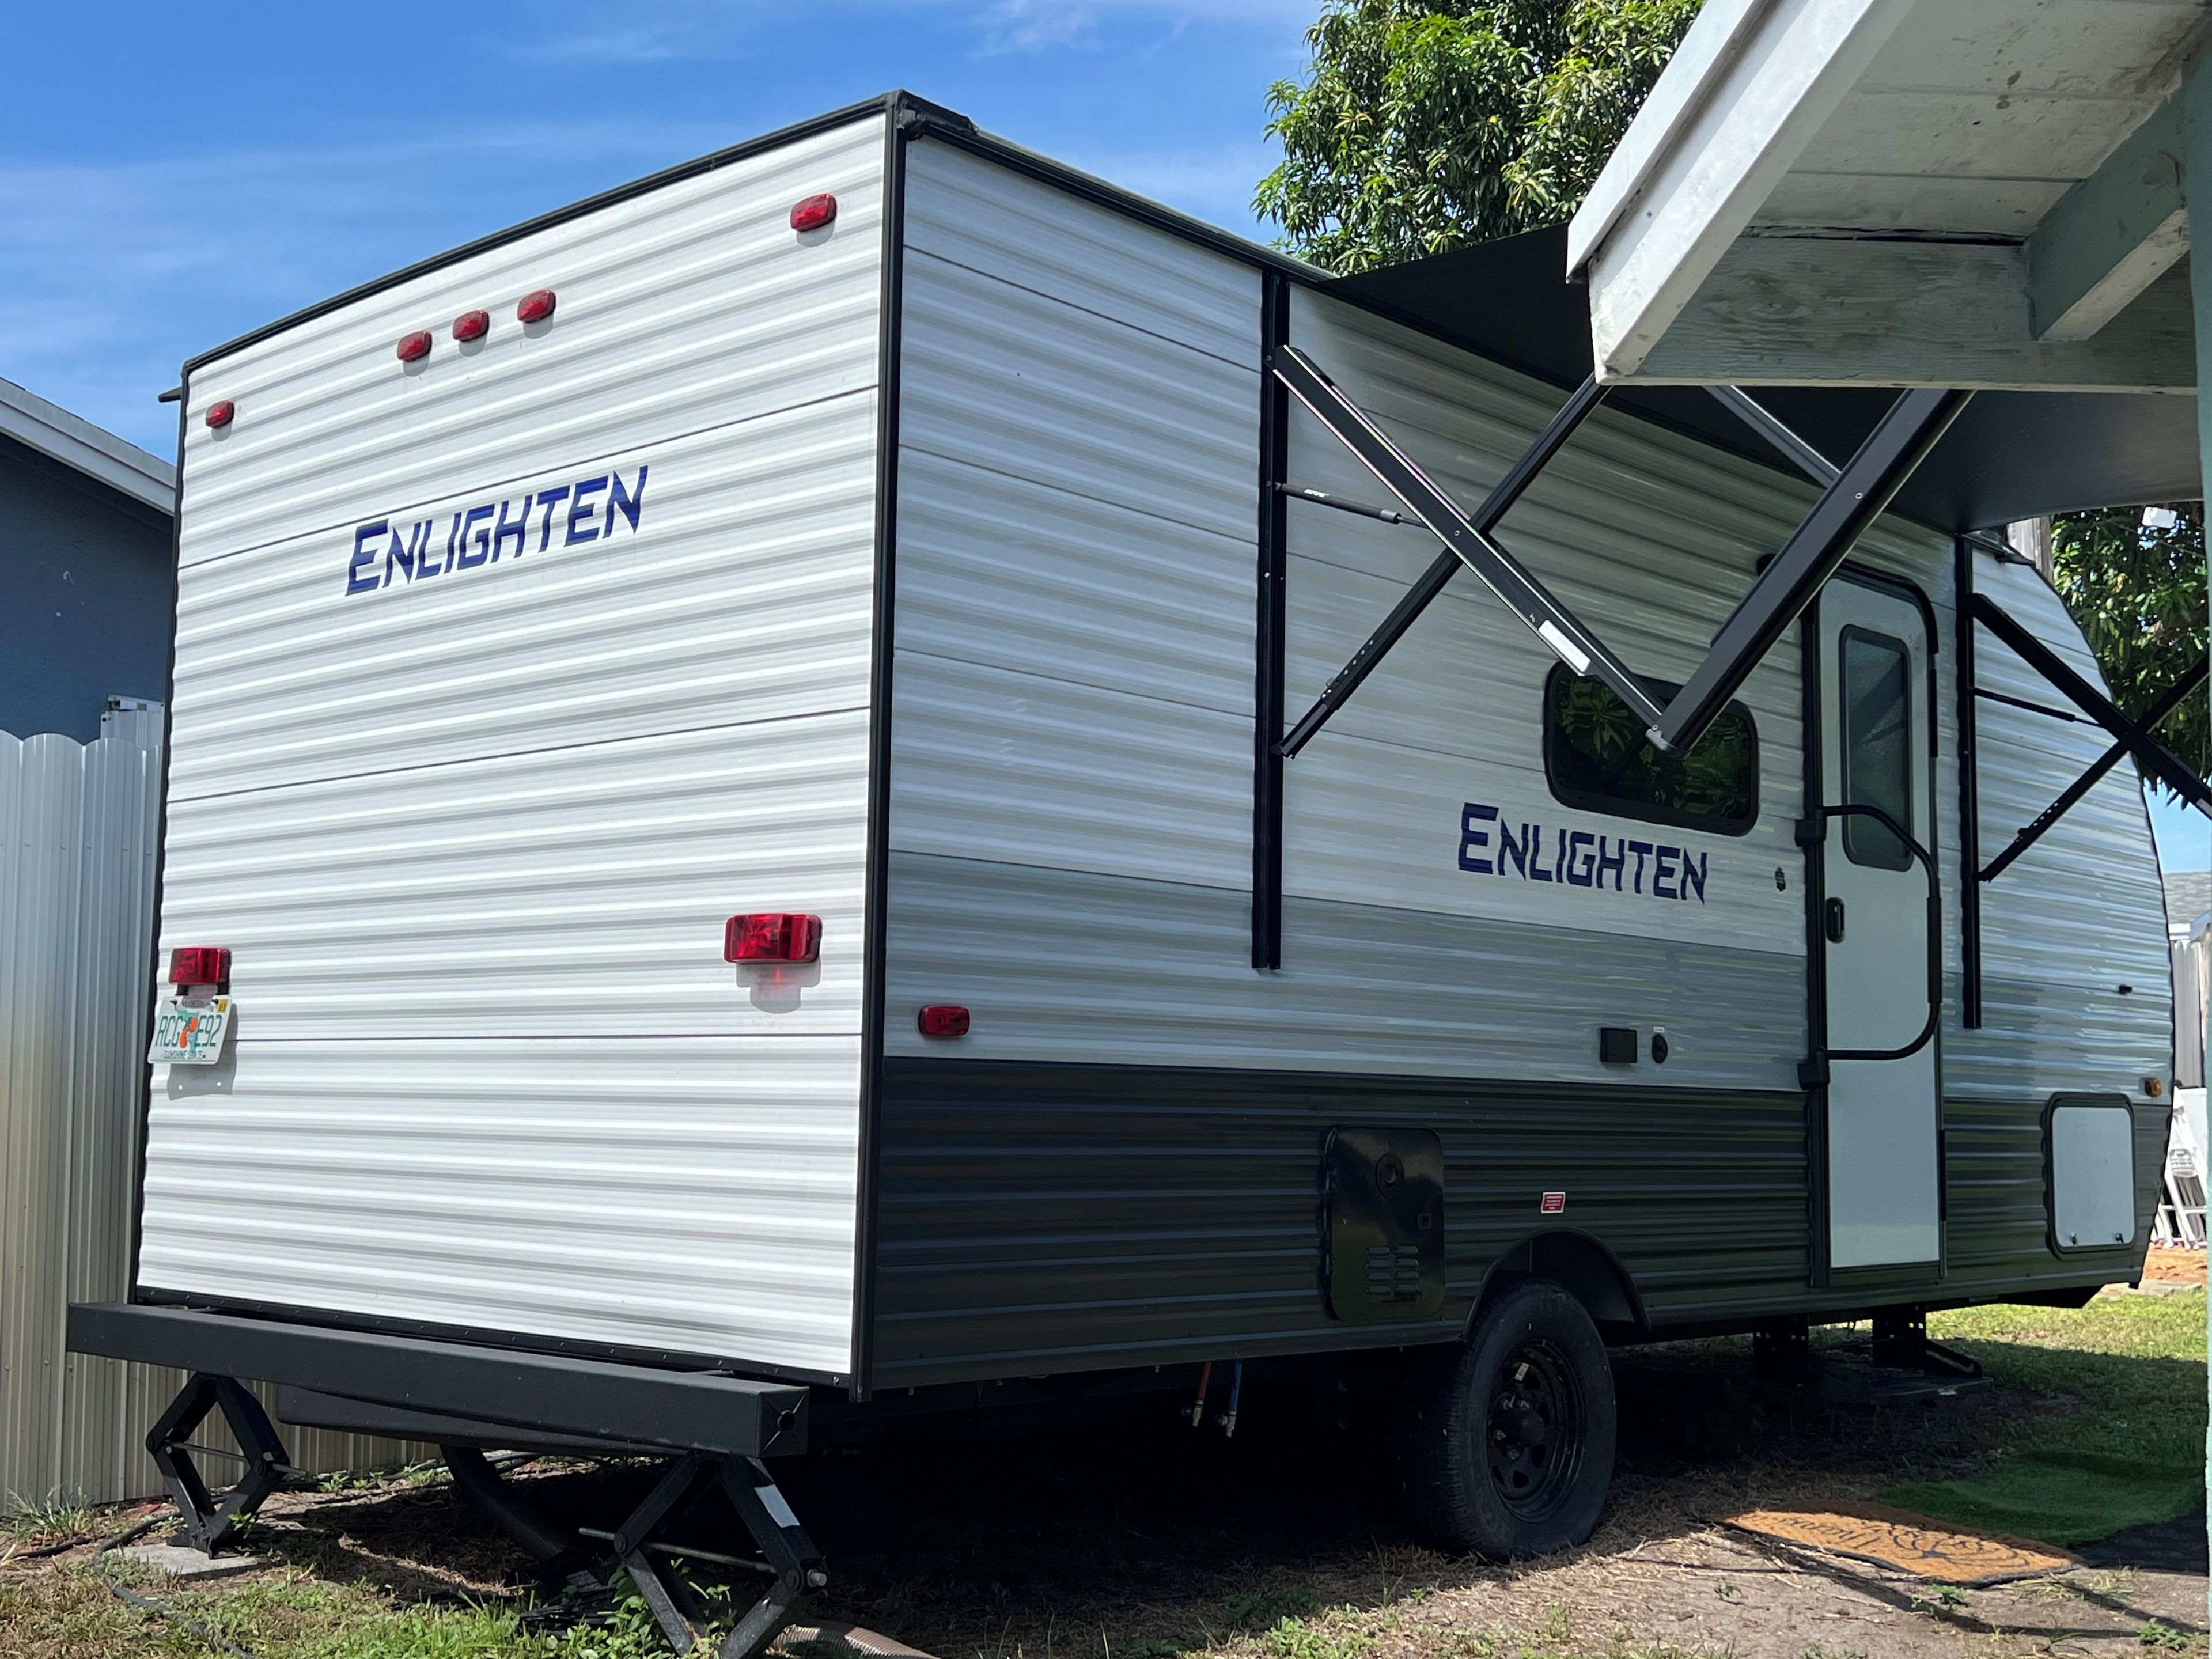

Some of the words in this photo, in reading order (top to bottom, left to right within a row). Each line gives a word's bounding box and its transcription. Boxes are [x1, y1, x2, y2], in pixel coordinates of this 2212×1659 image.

[345, 465, 649, 597] ENLIGHTEN
[1458, 802, 1707, 905] ENLIGHTEN
[194, 1014, 222, 1047] E92
